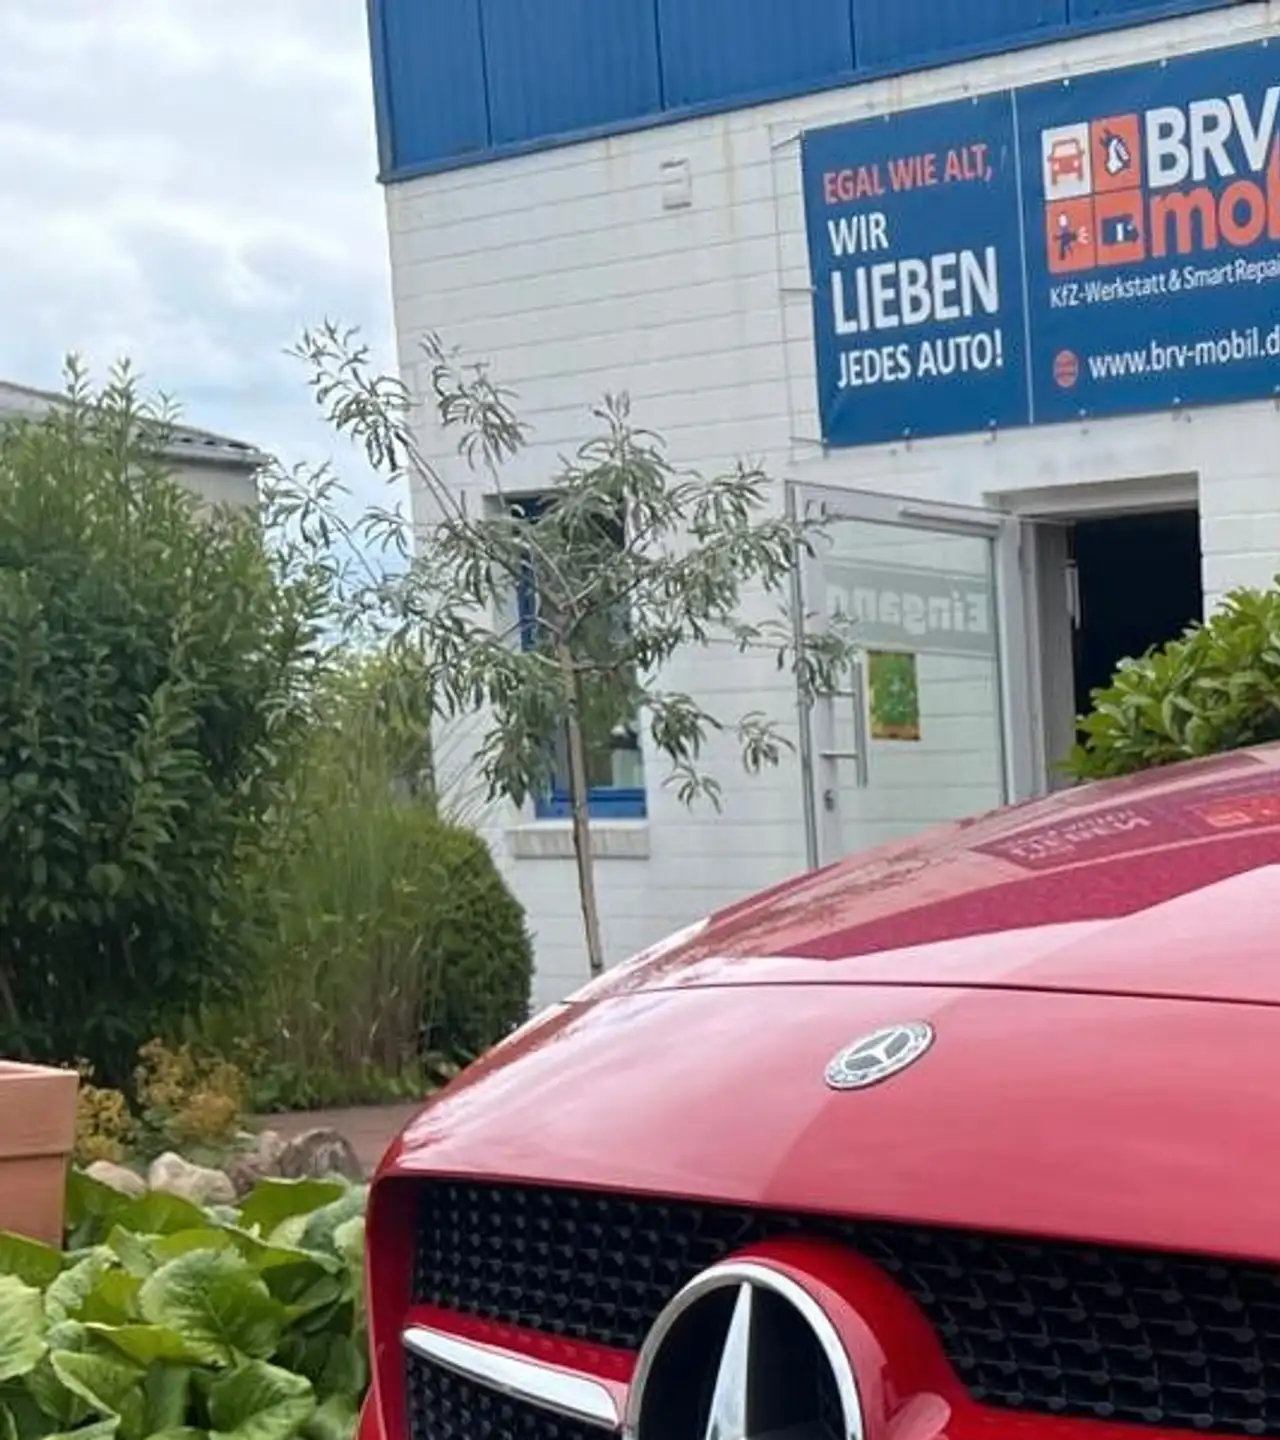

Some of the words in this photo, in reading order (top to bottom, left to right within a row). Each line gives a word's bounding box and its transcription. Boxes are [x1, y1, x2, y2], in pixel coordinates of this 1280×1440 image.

[1145, 86, 1280, 188] BRV
[823, 163, 885, 205] EGAL
[888, 153, 938, 191] WIE
[944, 144, 992, 182] ALT,
[827, 212, 889, 256] WIR
[831, 246, 999, 335] LIEBEN
[1050, 274, 1166, 308] KfZ-Werkstatt
[1168, 269, 1182, 292] &
[836, 343, 911, 389] JEDES
[917, 329, 1003, 378] AUTO!
